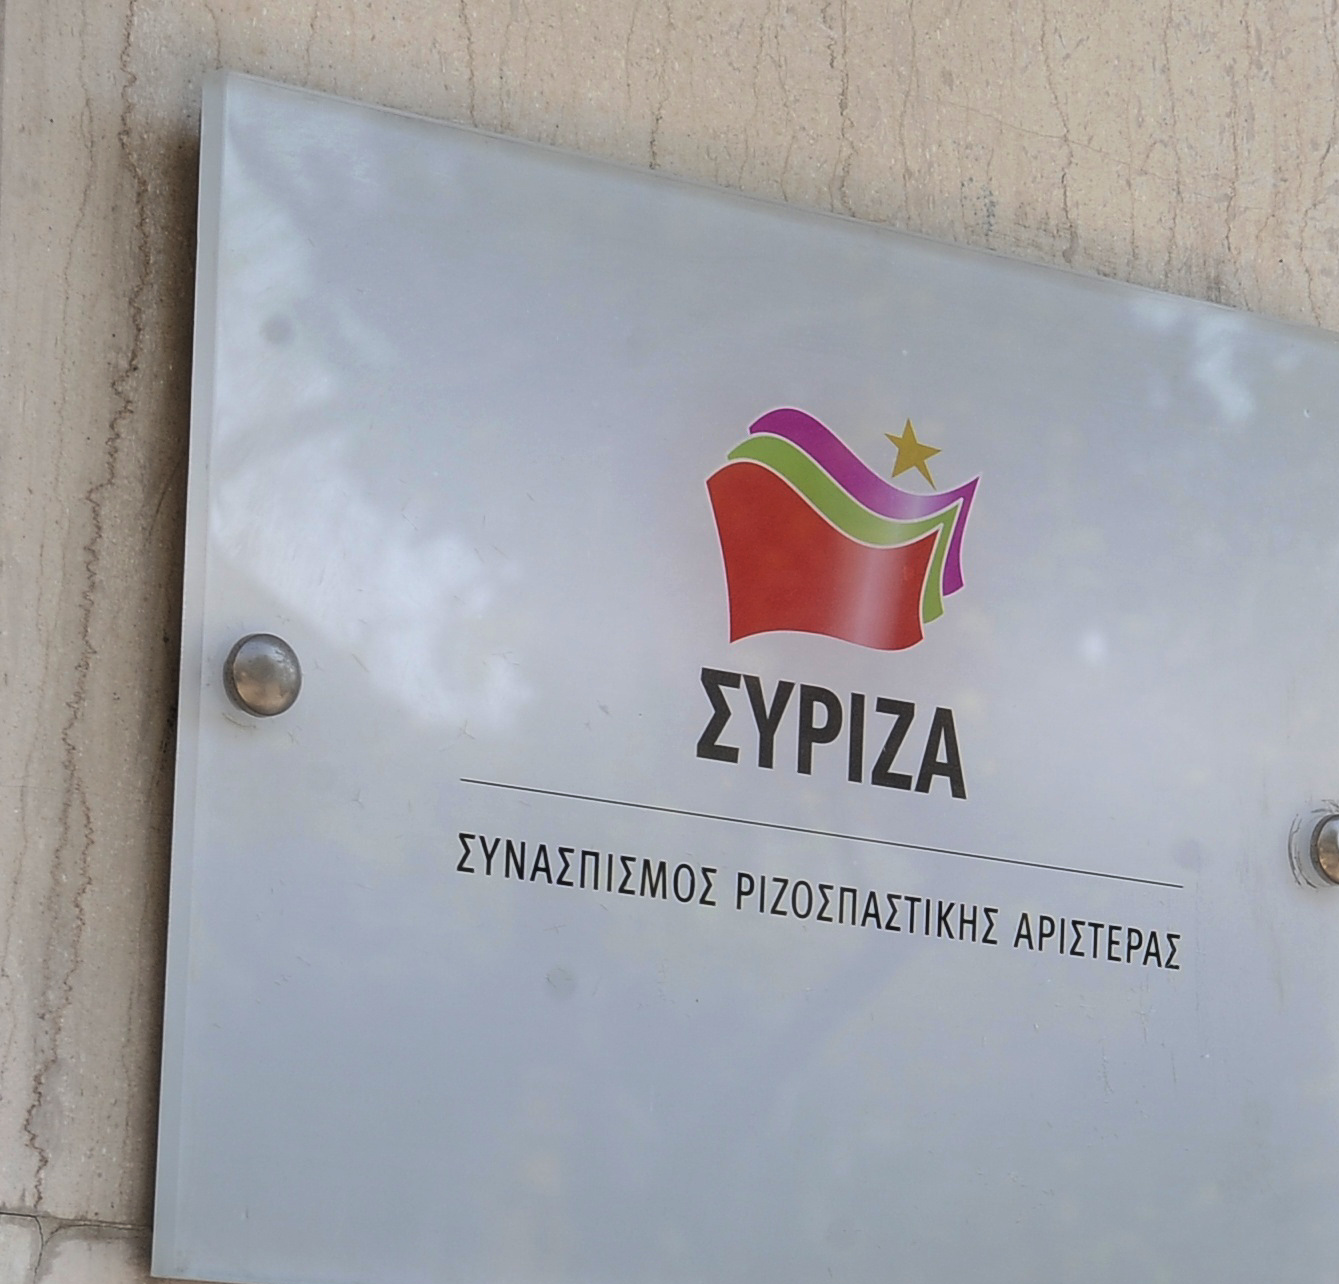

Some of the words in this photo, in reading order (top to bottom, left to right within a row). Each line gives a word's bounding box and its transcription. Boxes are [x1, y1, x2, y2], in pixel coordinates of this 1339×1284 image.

[696, 667, 967, 800] ΣΥΡΙΖΑ
[456, 833, 717, 906] ΣΥΝΑΣΠΙΣΜΟΣ
[736, 872, 999, 945] ΡΙΖΟΣΠΑΣΤΙΚΗΣ
[1013, 913, 1181, 970] ΑΡΙΣΤΕΡΑΣ
